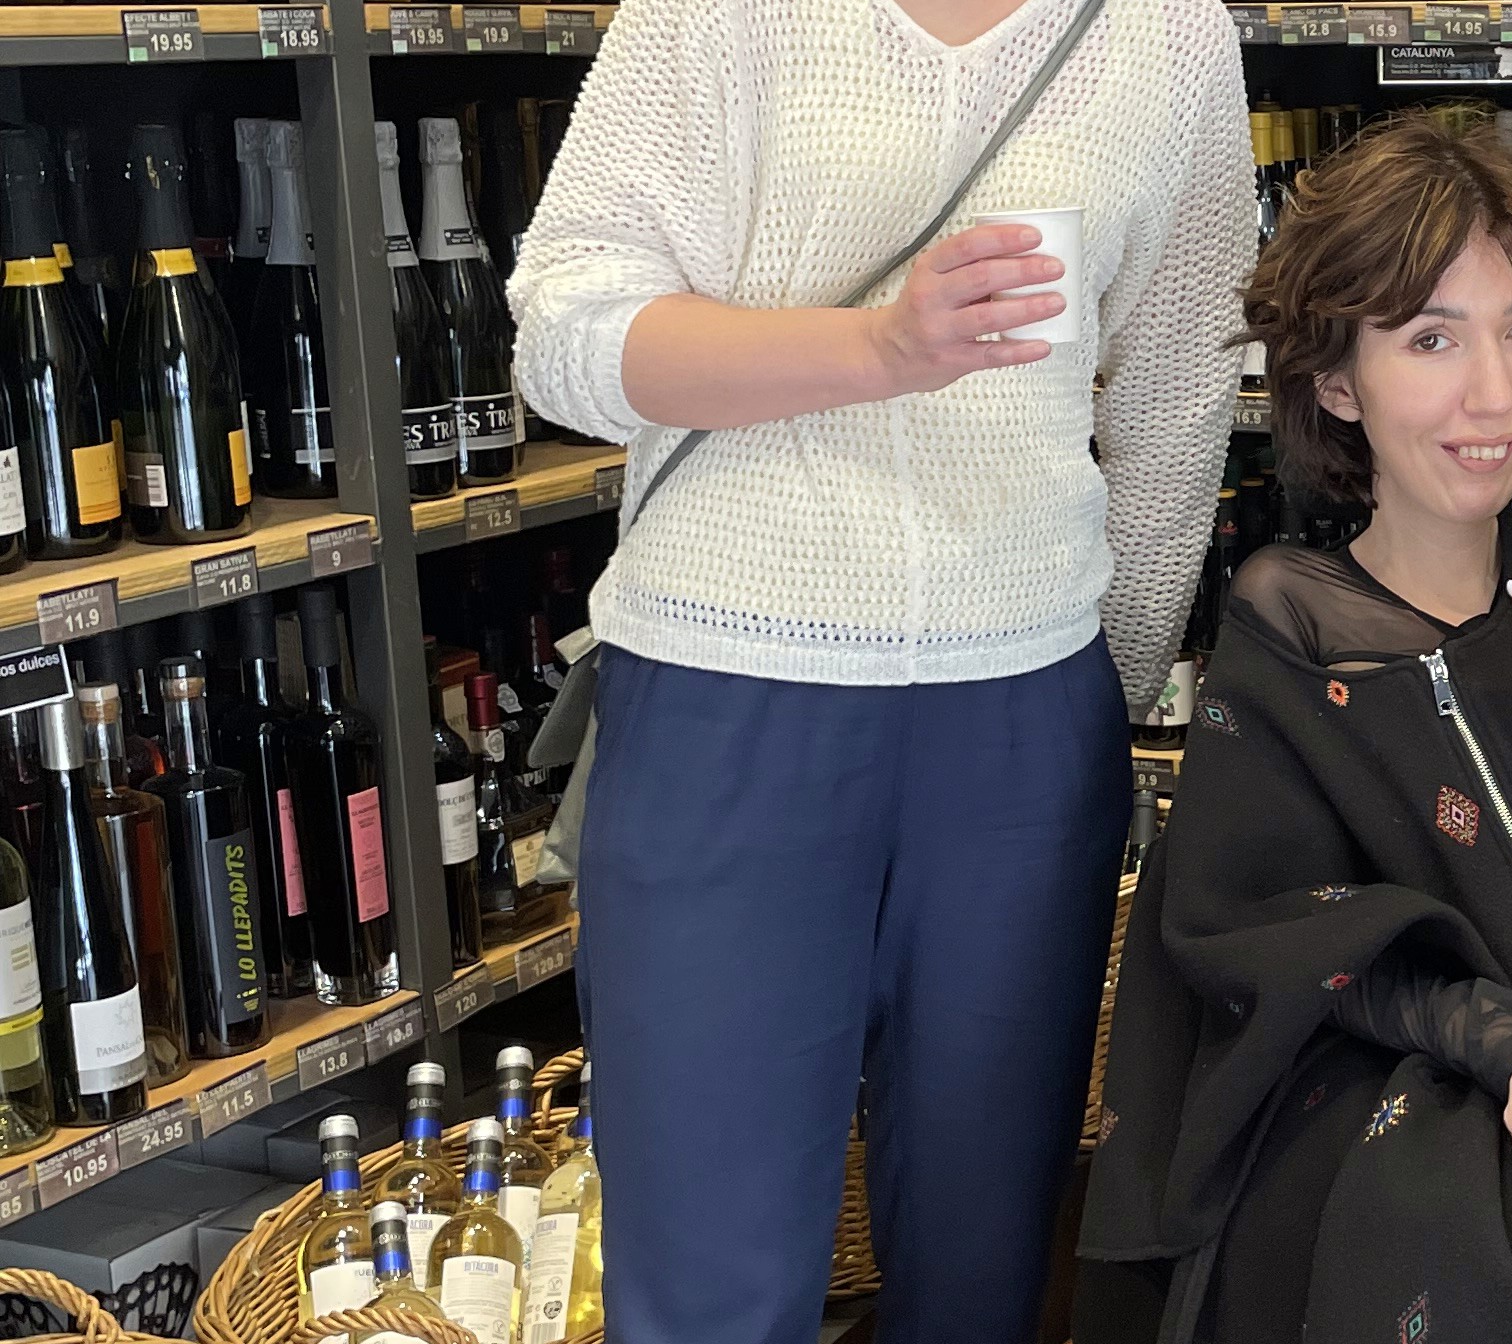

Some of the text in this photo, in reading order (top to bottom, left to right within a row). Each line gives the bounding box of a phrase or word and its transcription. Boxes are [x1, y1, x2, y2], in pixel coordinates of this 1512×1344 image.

[409, 28, 444, 45] 19.95
[483, 27, 508, 44] 19.9
[1301, 20, 1330, 37] 12.8
[1368, 23, 1397, 38] 15.9
[1445, 20, 1482, 36] 14.95
[150, 34, 193, 52] 19.95
[280, 30, 319, 47] 18.95
[561, 30, 575, 46] 21
[1391, 45, 1455, 58] CATALUNYA
[487, 509, 512, 527] 12.5
[331, 550, 341, 566] 9
[220, 574, 252, 597] 11.8
[65, 608, 100, 634] 11.9
[18, 651, 60, 674] dulces
[455, 991, 478, 1012] 120
[319, 1051, 348, 1076] 13.8
[222, 1090, 254, 1116] 11.5
[141, 1123, 184, 1150] 24.95
[63, 1153, 108, 1187] 10.95
